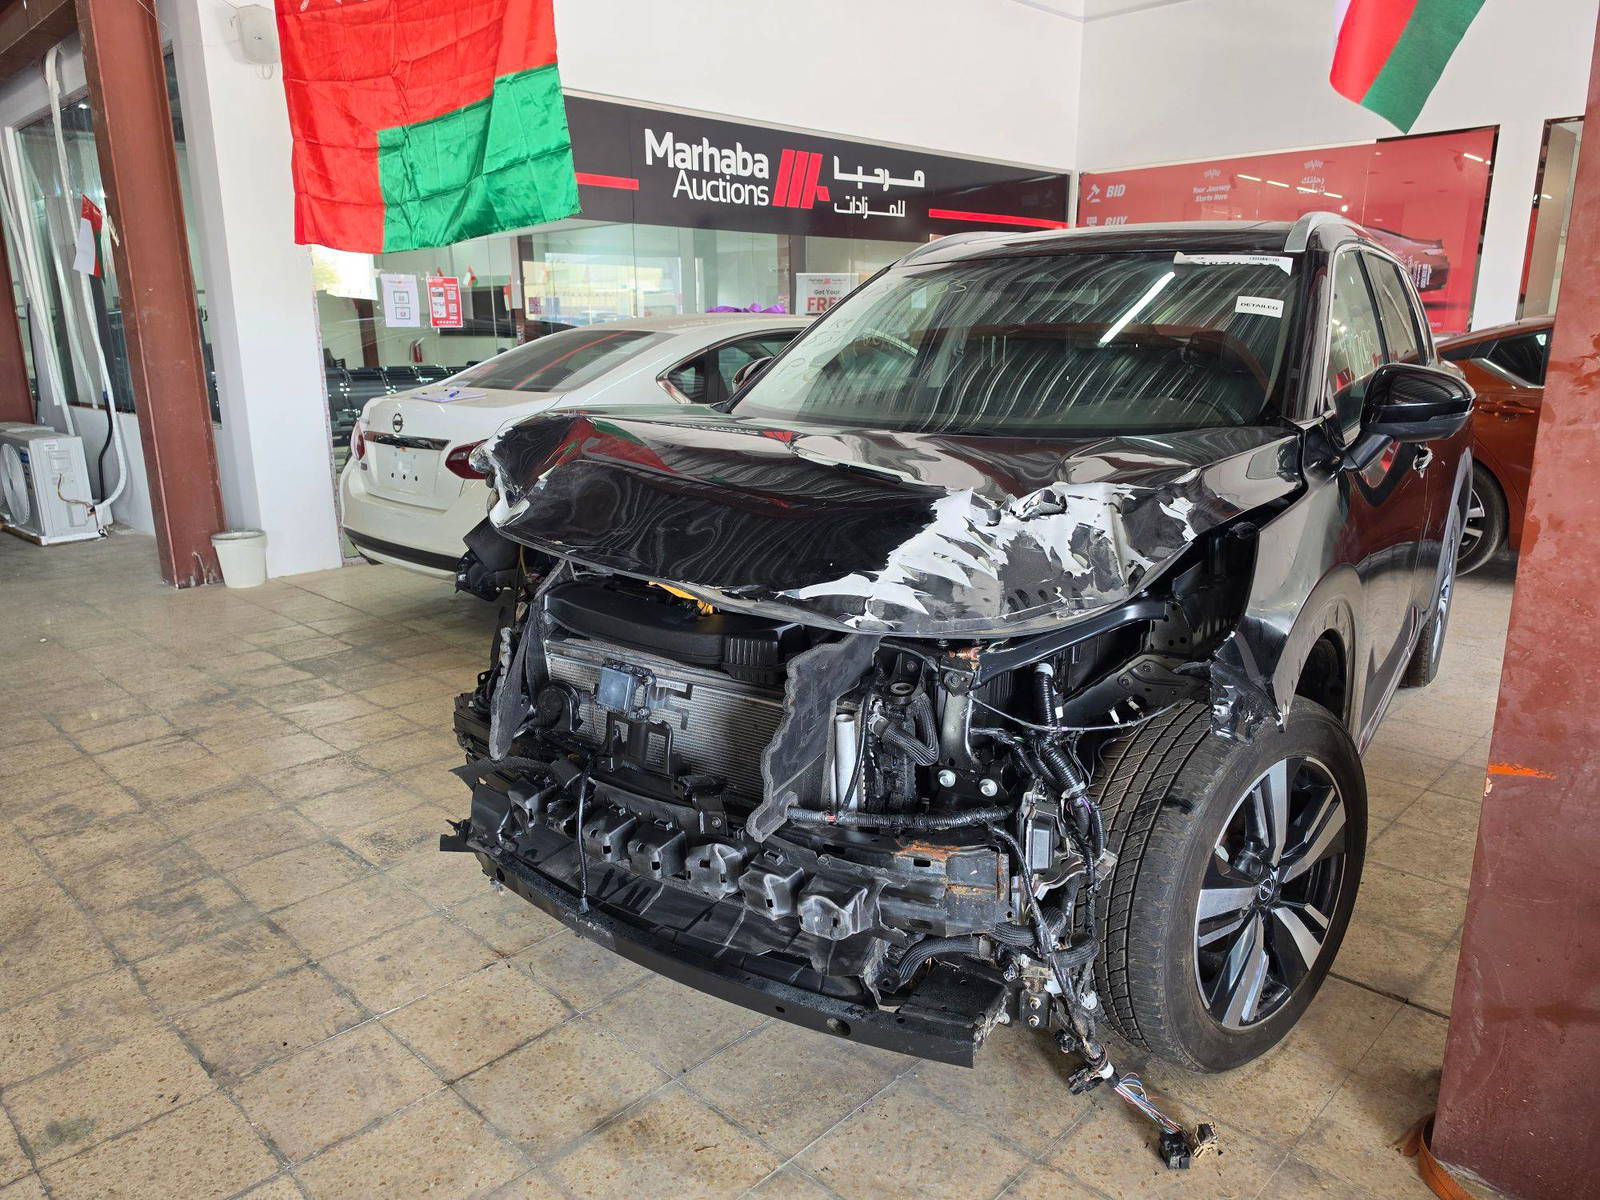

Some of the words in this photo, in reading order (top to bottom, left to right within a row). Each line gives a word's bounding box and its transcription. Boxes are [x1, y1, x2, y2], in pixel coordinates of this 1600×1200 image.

[645, 128, 769, 179] Marhaba
[673, 169, 770, 206] Auctions
[834, 155, 925, 191] مرحبا
[1106, 184, 1126, 198] BID
[834, 196, 905, 219] للمزادات
[807, 297, 845, 312] FRE
